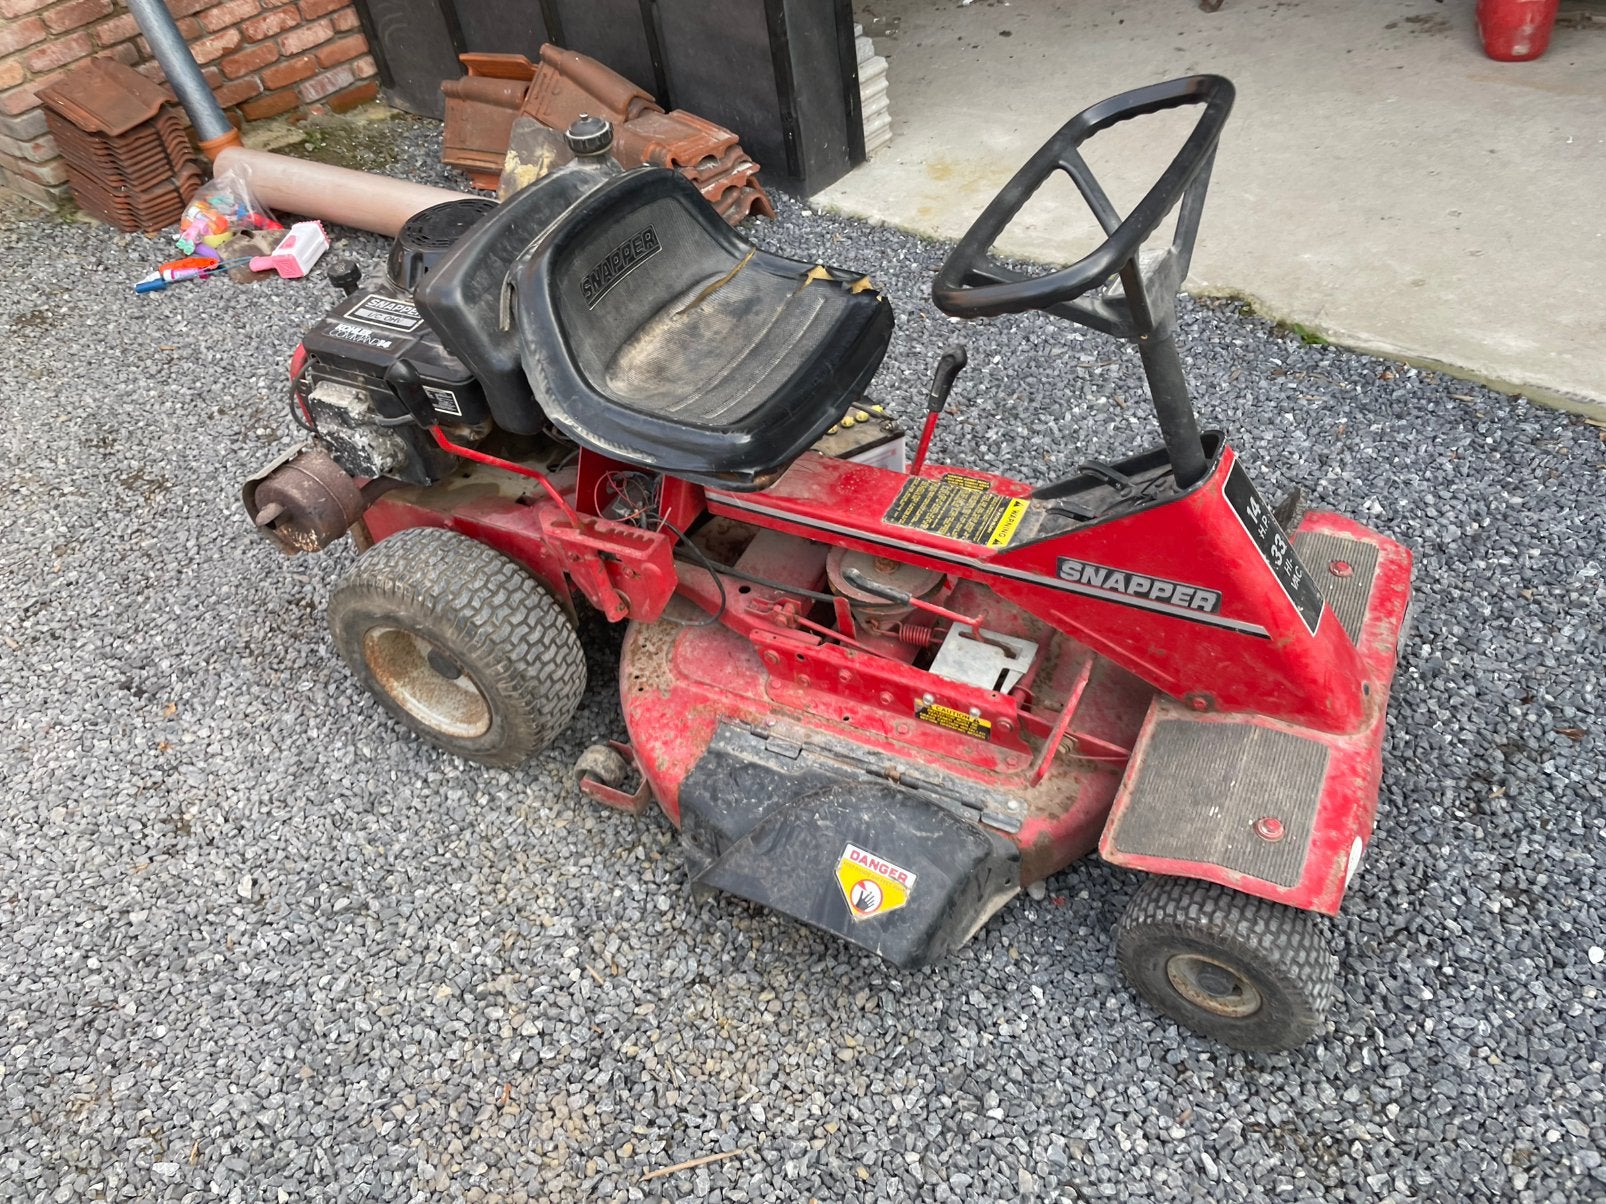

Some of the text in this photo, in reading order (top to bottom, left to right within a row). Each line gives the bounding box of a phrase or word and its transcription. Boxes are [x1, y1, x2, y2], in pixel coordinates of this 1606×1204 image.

[582, 229, 658, 299] SNAPPER
[367, 299, 419, 316] SNAPPE
[329, 329, 381, 346] COMMAND
[335, 323, 373, 336] KOHLER
[999, 509, 1019, 538] WARNING
[1246, 496, 1261, 524] 14
[1271, 533, 1288, 566] 33
[1059, 560, 1217, 612] SNAPPER
[1291, 566, 1303, 590] VAC
[935, 705, 971, 720] CAUTION
[849, 849, 908, 883] DANGER
